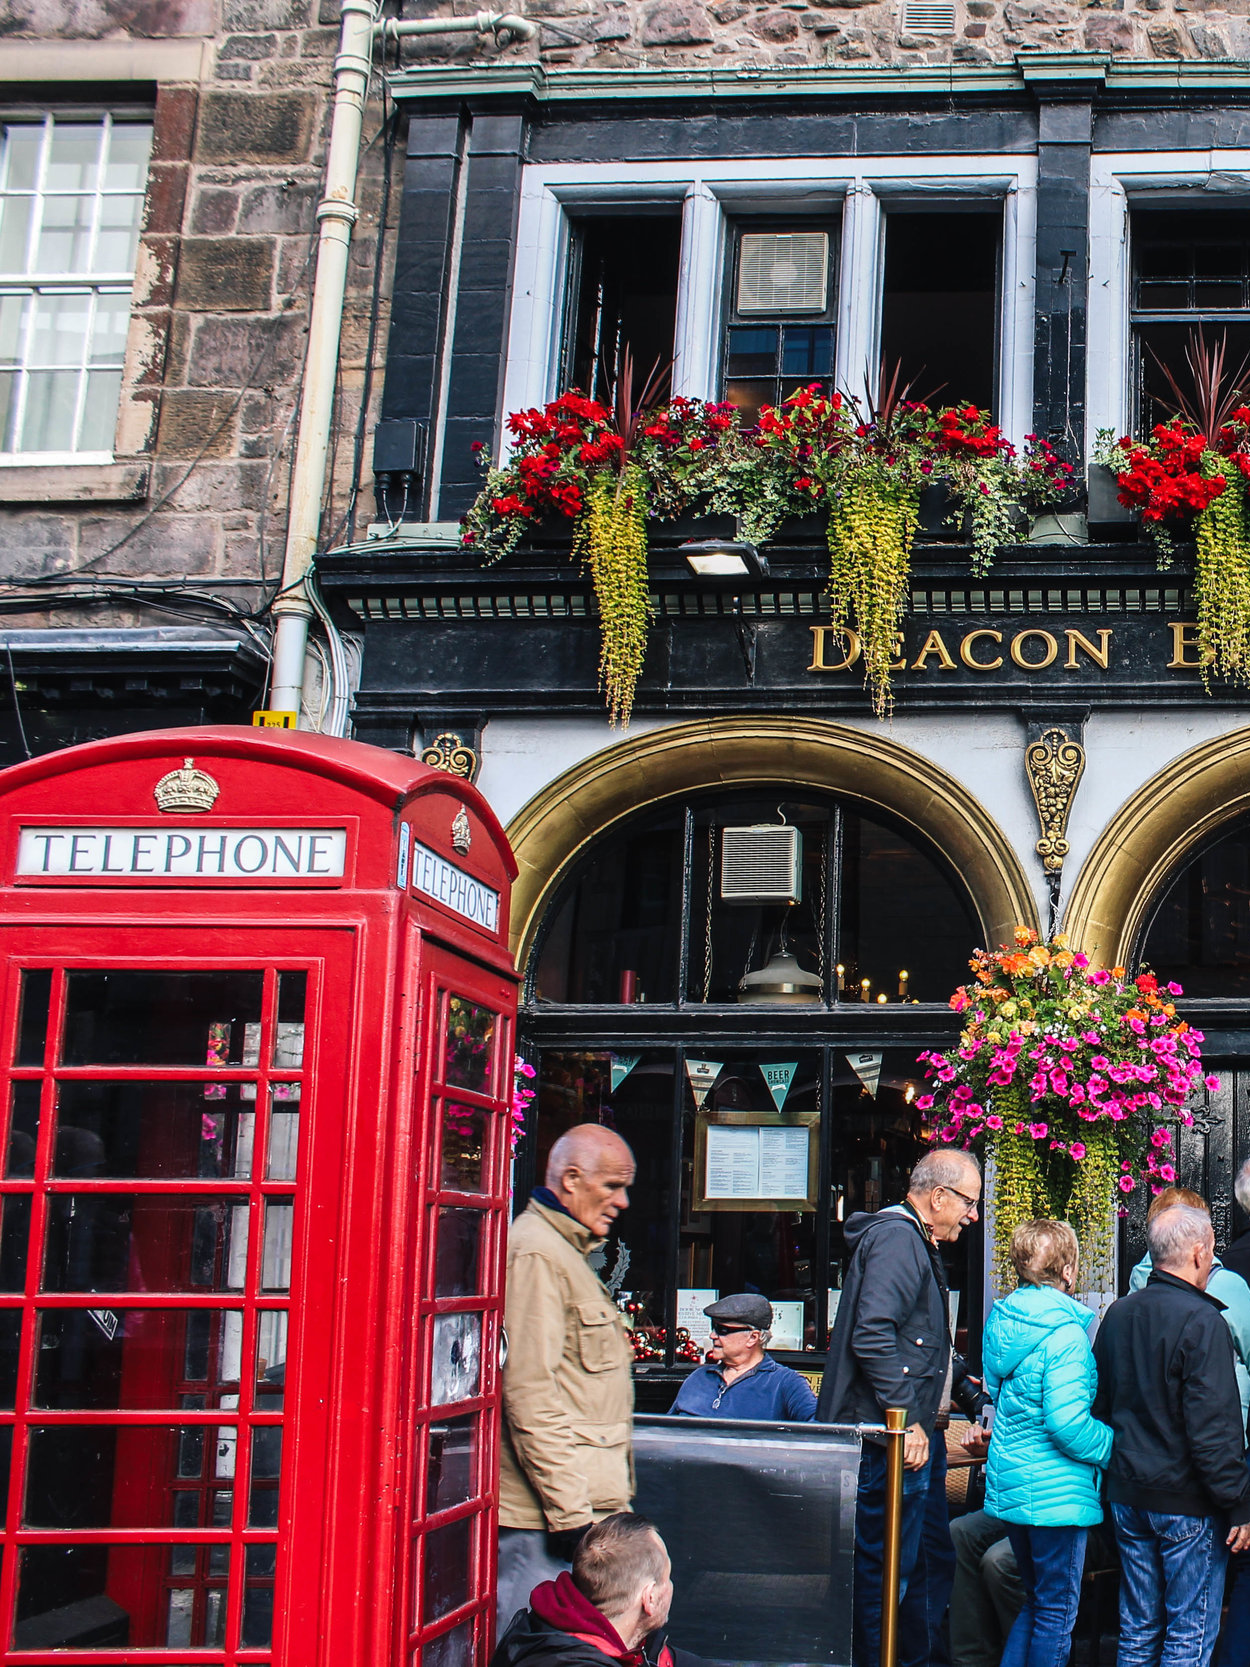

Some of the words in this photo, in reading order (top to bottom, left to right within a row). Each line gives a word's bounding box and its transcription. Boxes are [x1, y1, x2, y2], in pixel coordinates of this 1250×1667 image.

[34, 834, 333, 873] TELEPHONE
[414, 847, 494, 927] TELEPHONE
[768, 1070, 790, 1080] BEER
